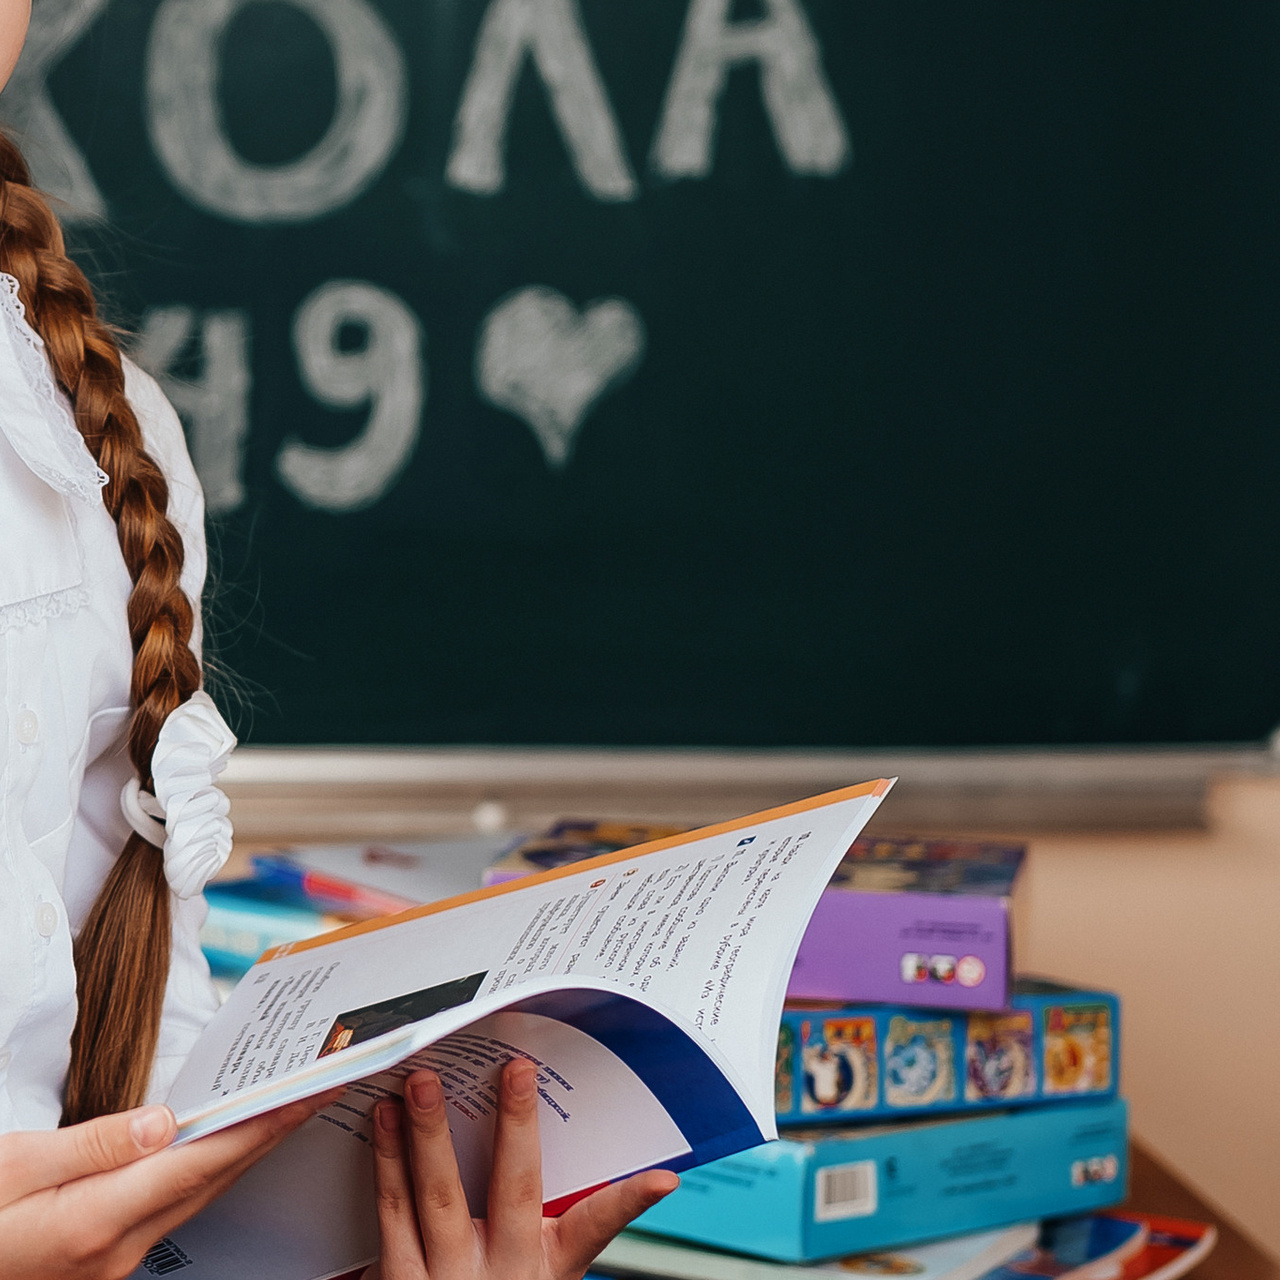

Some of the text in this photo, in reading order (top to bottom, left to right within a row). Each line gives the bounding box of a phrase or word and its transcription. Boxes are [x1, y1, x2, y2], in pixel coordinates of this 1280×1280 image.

[695, 897, 712, 915] одно
[579, 905, 610, 948] существуют
[658, 906, 688, 950] сообщение
[604, 932, 629, 968] русского
[649, 956, 660, 968] об
[709, 933, 733, 971] рубрике
[709, 944, 743, 1027] географические
[231, 1034, 255, 1074] словарь
[265, 1038, 289, 1078] словаре
[236, 1057, 256, 1091] толко
